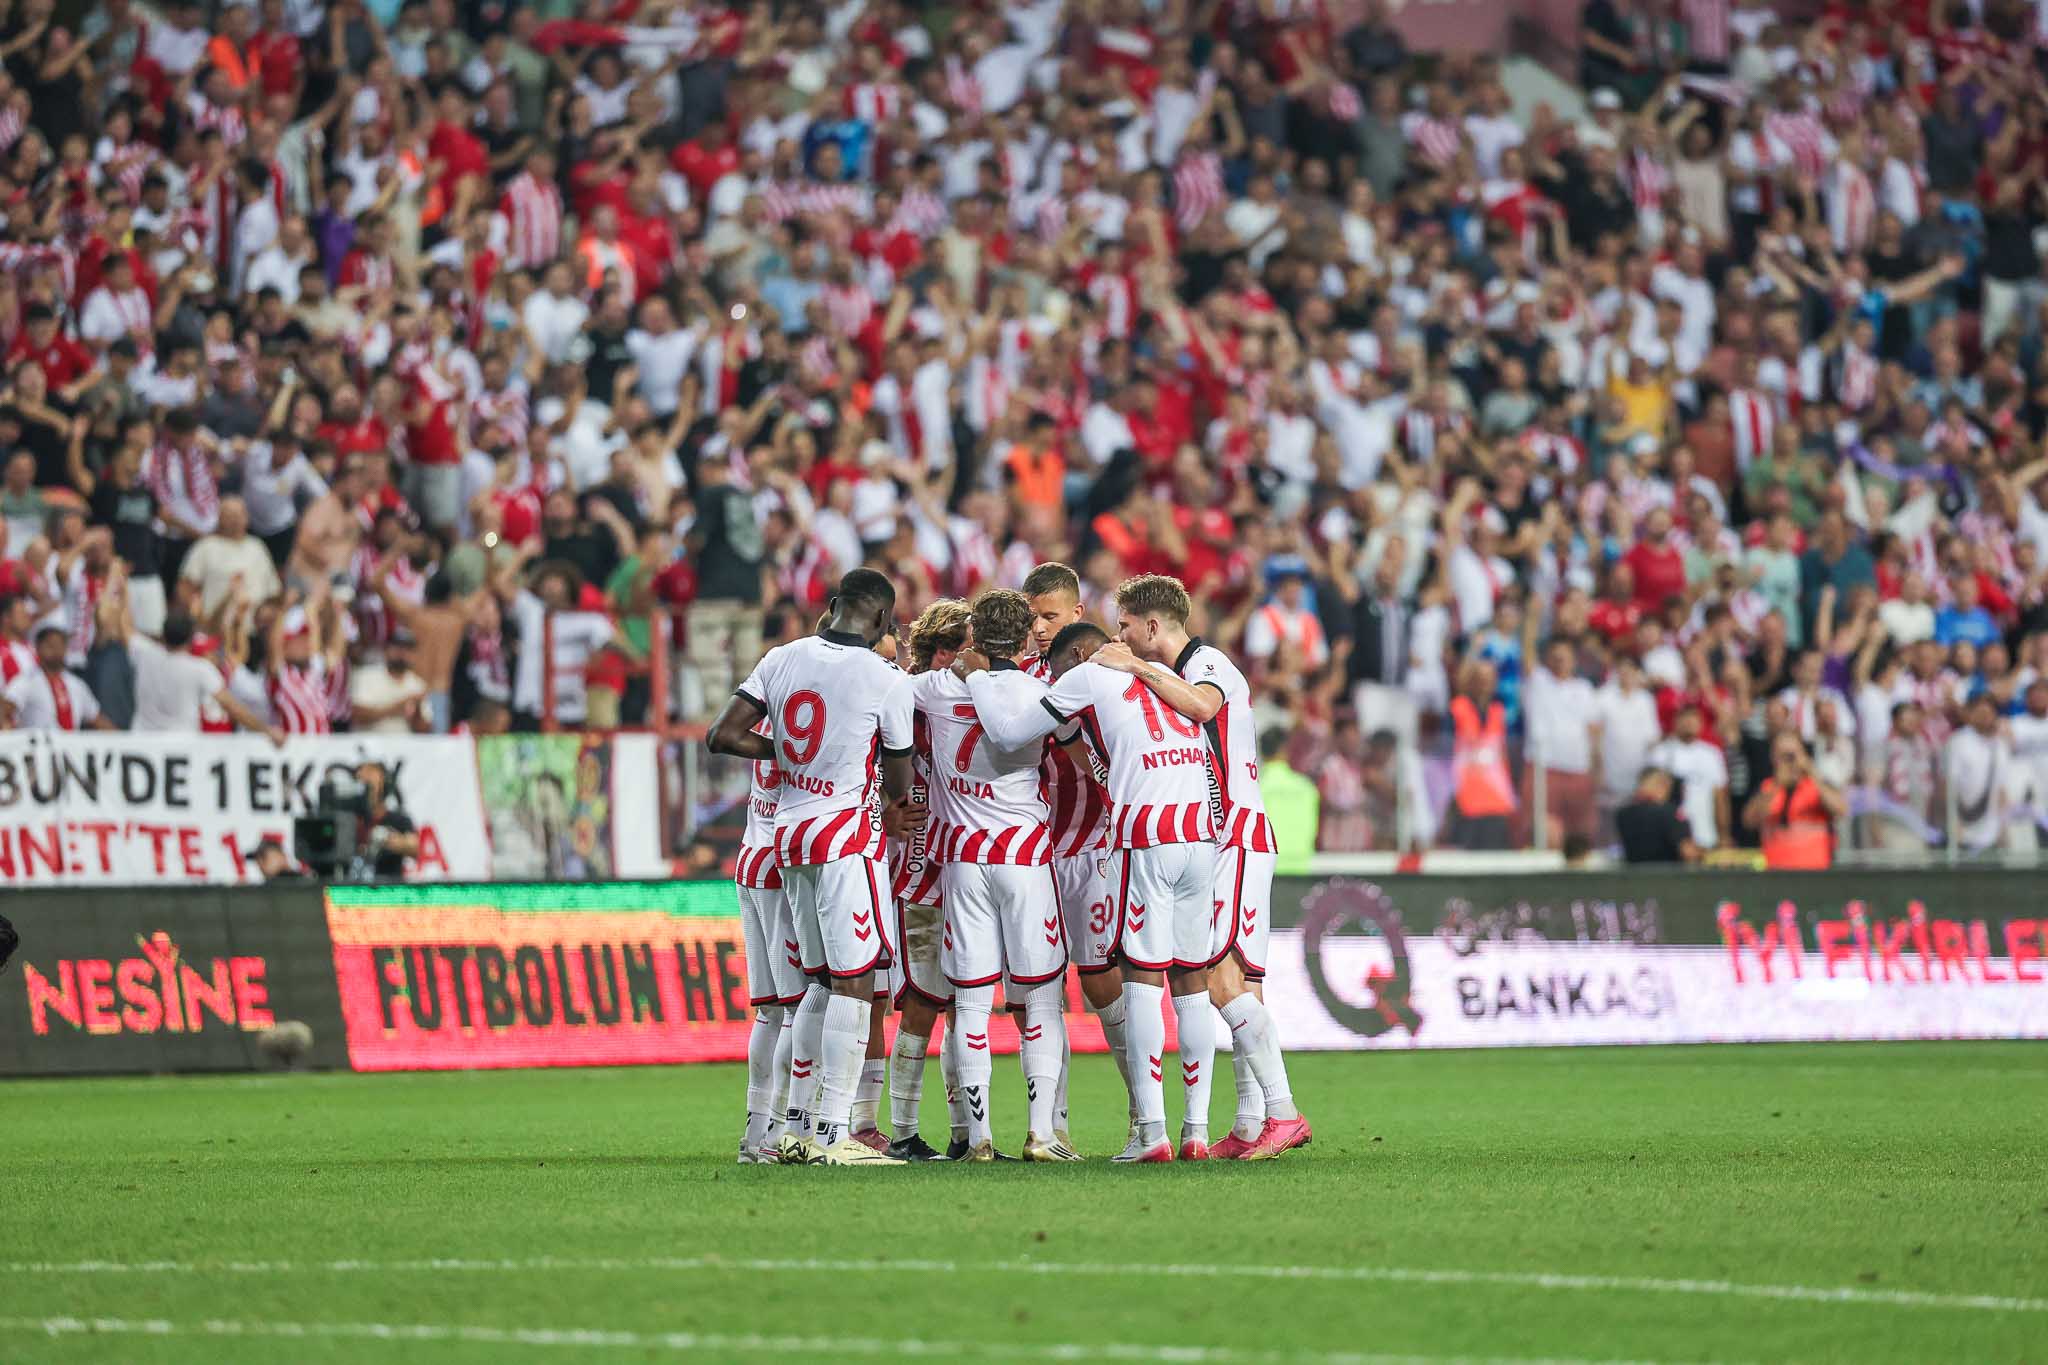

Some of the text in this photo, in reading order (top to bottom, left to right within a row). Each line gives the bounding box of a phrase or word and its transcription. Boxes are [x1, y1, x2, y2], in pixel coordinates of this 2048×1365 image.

[783, 690, 826, 765] 9
[953, 704, 985, 773] 7
[1815, 901, 2048, 983] FİKİRLE
[373, 943, 663, 1031] FUTBOLUN
